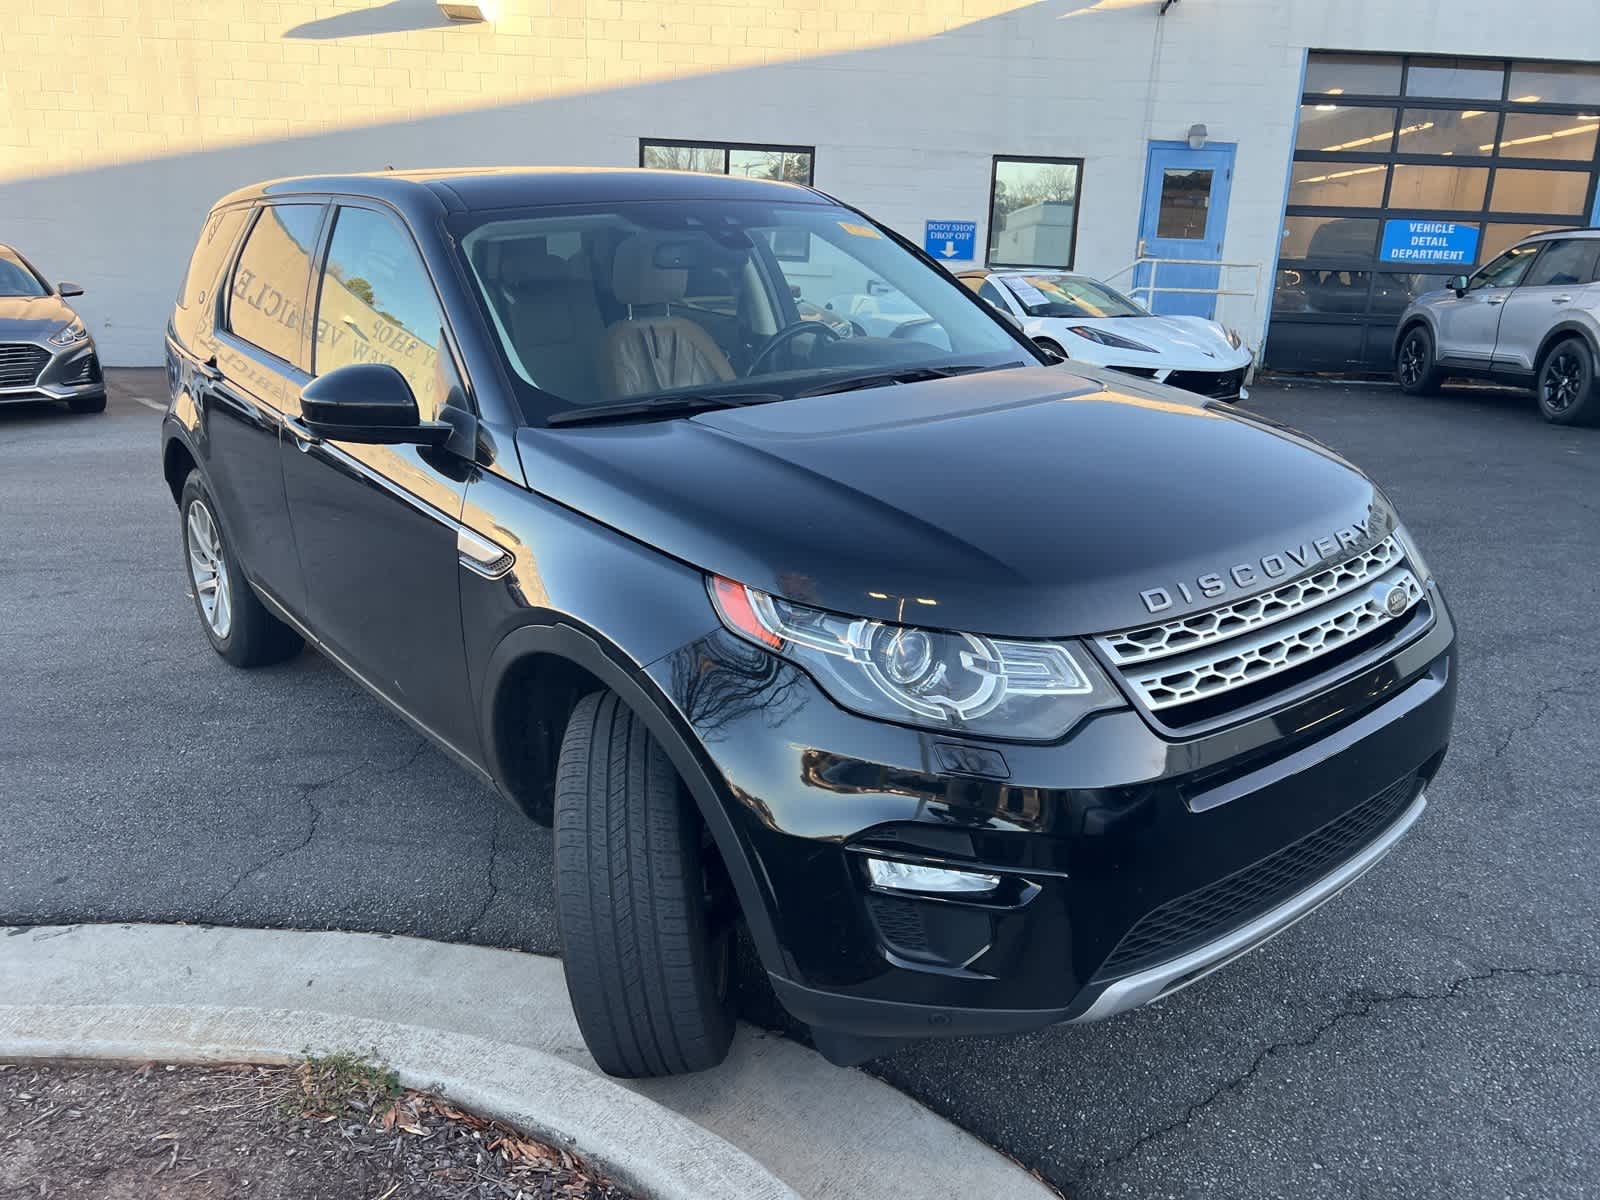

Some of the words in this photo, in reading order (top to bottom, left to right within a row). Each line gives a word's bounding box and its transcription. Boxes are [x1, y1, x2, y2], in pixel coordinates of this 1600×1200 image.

[927, 223, 951, 231] BODY
[951, 223, 975, 231] SHOP
[1409, 222, 1456, 234] VEHICLE
[930, 231, 954, 240] DROP
[954, 232, 972, 240] OFF
[1411, 235, 1449, 247] DETAIL
[1391, 248, 1465, 260] DEPARTMENT
[1139, 520, 1371, 613] DISCOVERY
